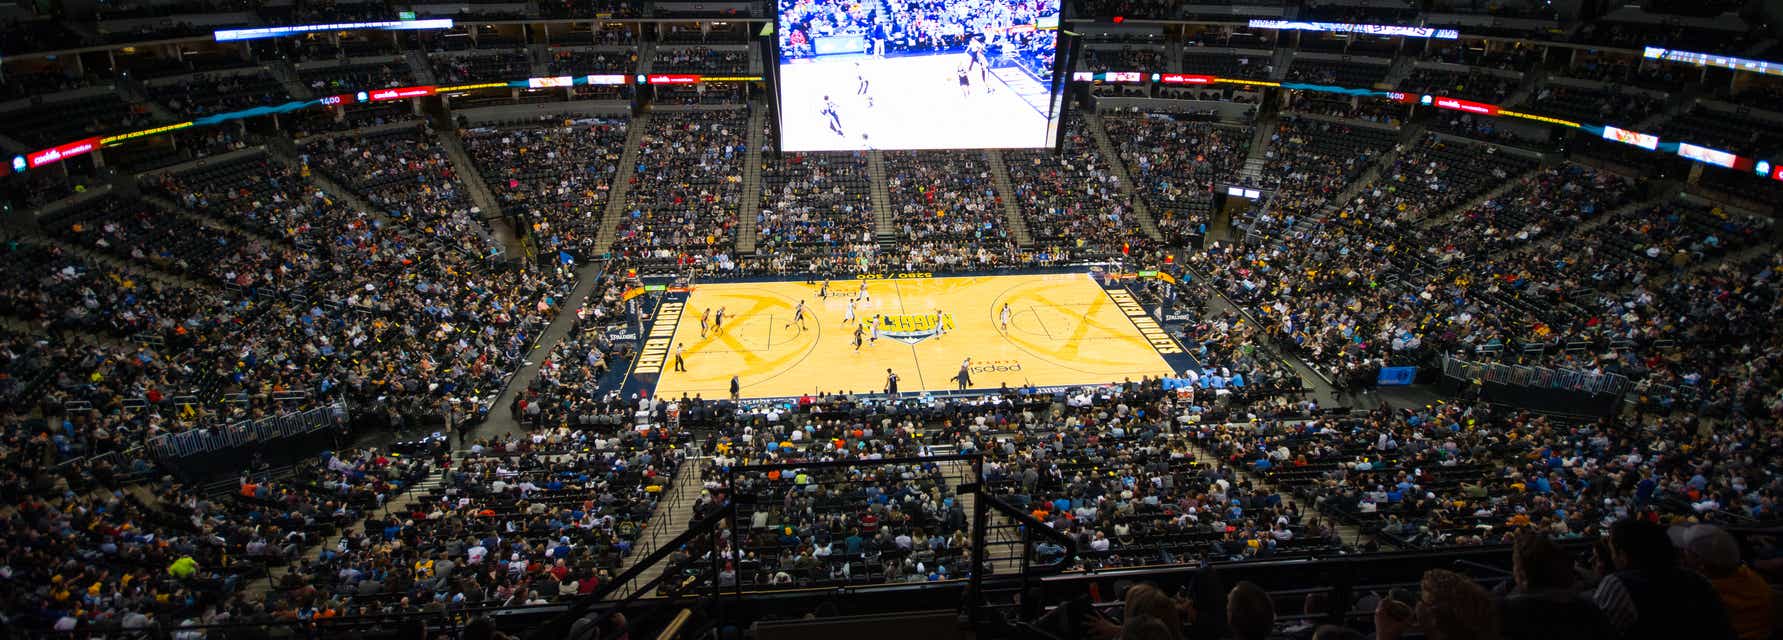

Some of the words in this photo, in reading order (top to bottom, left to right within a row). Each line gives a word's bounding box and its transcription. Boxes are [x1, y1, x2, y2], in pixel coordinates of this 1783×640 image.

[320, 96, 340, 105] 1400
[1386, 92, 1404, 100] 1400
[649, 302, 684, 337] NUGGETS
[1105, 289, 1147, 316] DENVER
[1130, 316, 1184, 354] NUGGETS
[610, 333, 637, 341] SPALDING
[634, 338, 671, 374] DENVER
[969, 363, 1021, 375] pepsi
